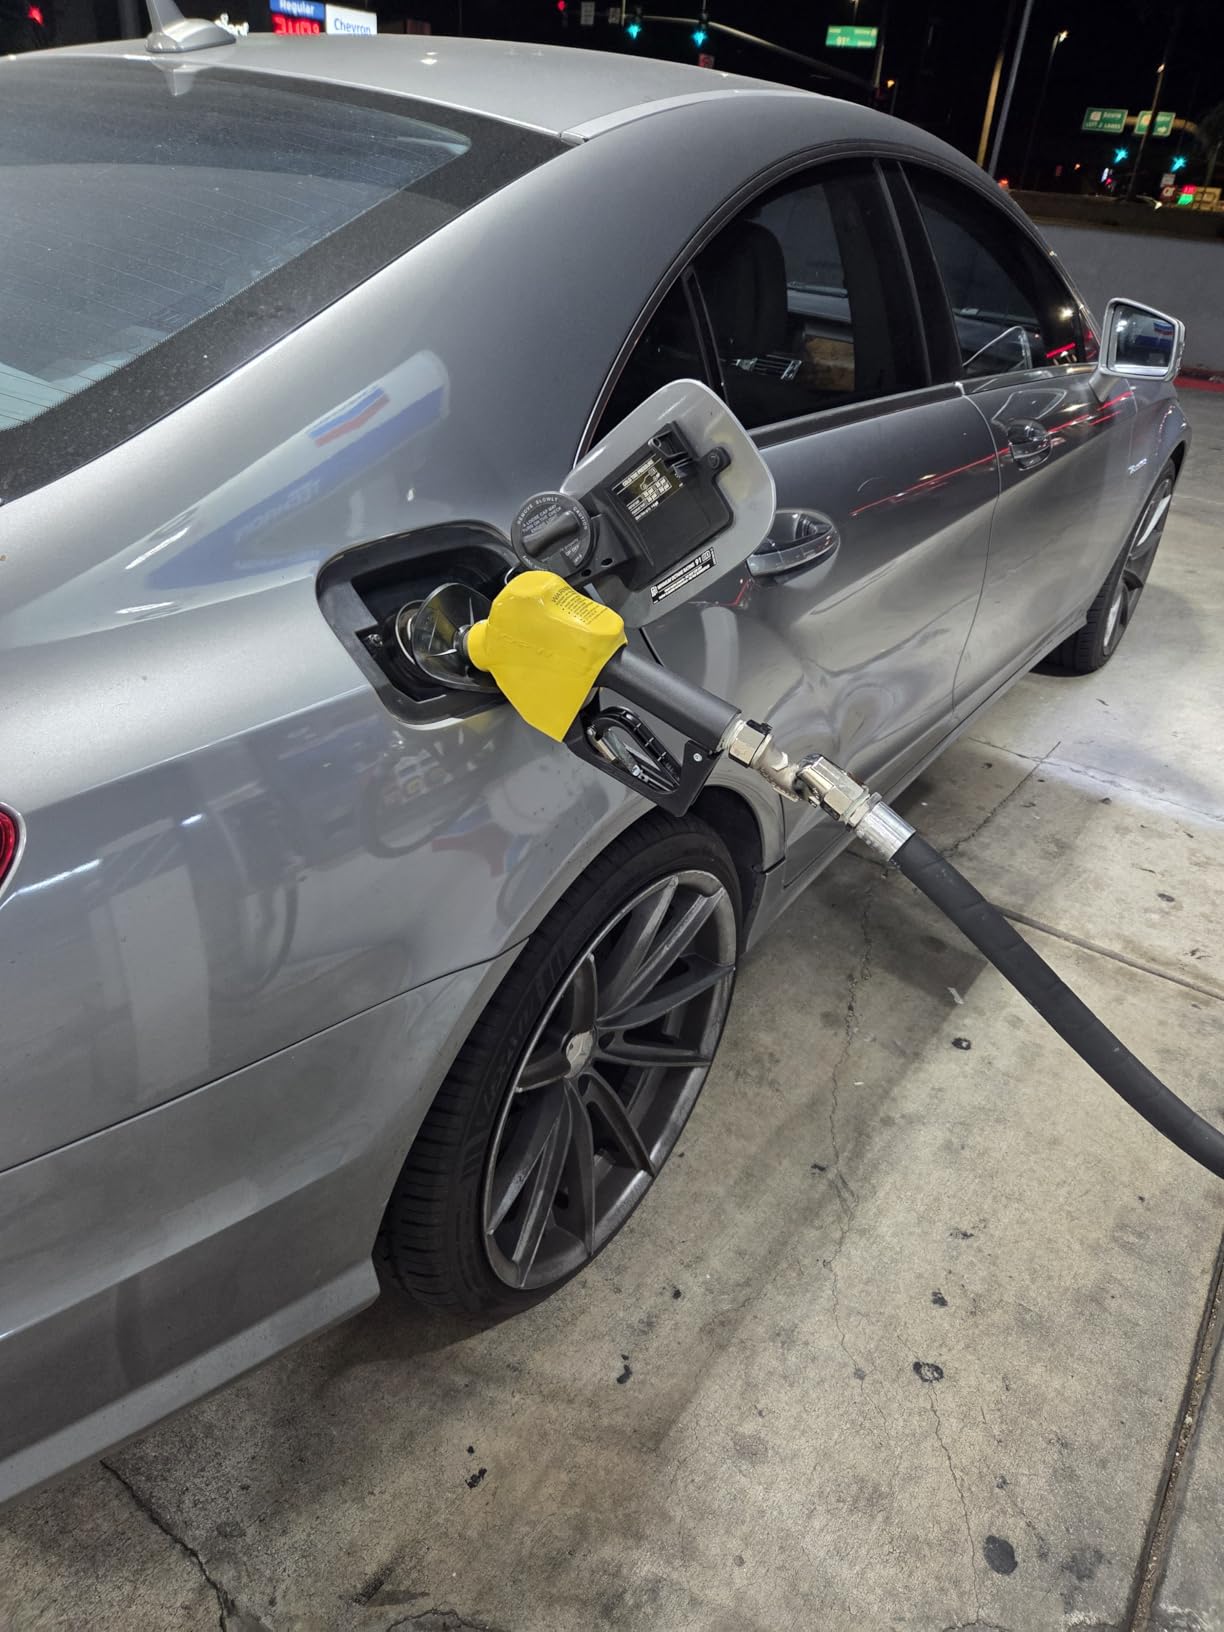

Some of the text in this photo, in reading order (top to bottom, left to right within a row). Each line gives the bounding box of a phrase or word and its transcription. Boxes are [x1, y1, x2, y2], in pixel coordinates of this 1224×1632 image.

[279, 0, 315, 16] Regular
[333, 18, 372, 35] Chevron
[517, 497, 558, 525] REMOVE SLOWLY
[539, 508, 548, 517] CAP
[548, 506, 561, 517] CHECK
[573, 506, 588, 530] CAUTION
[694, 556, 702, 566] 91
